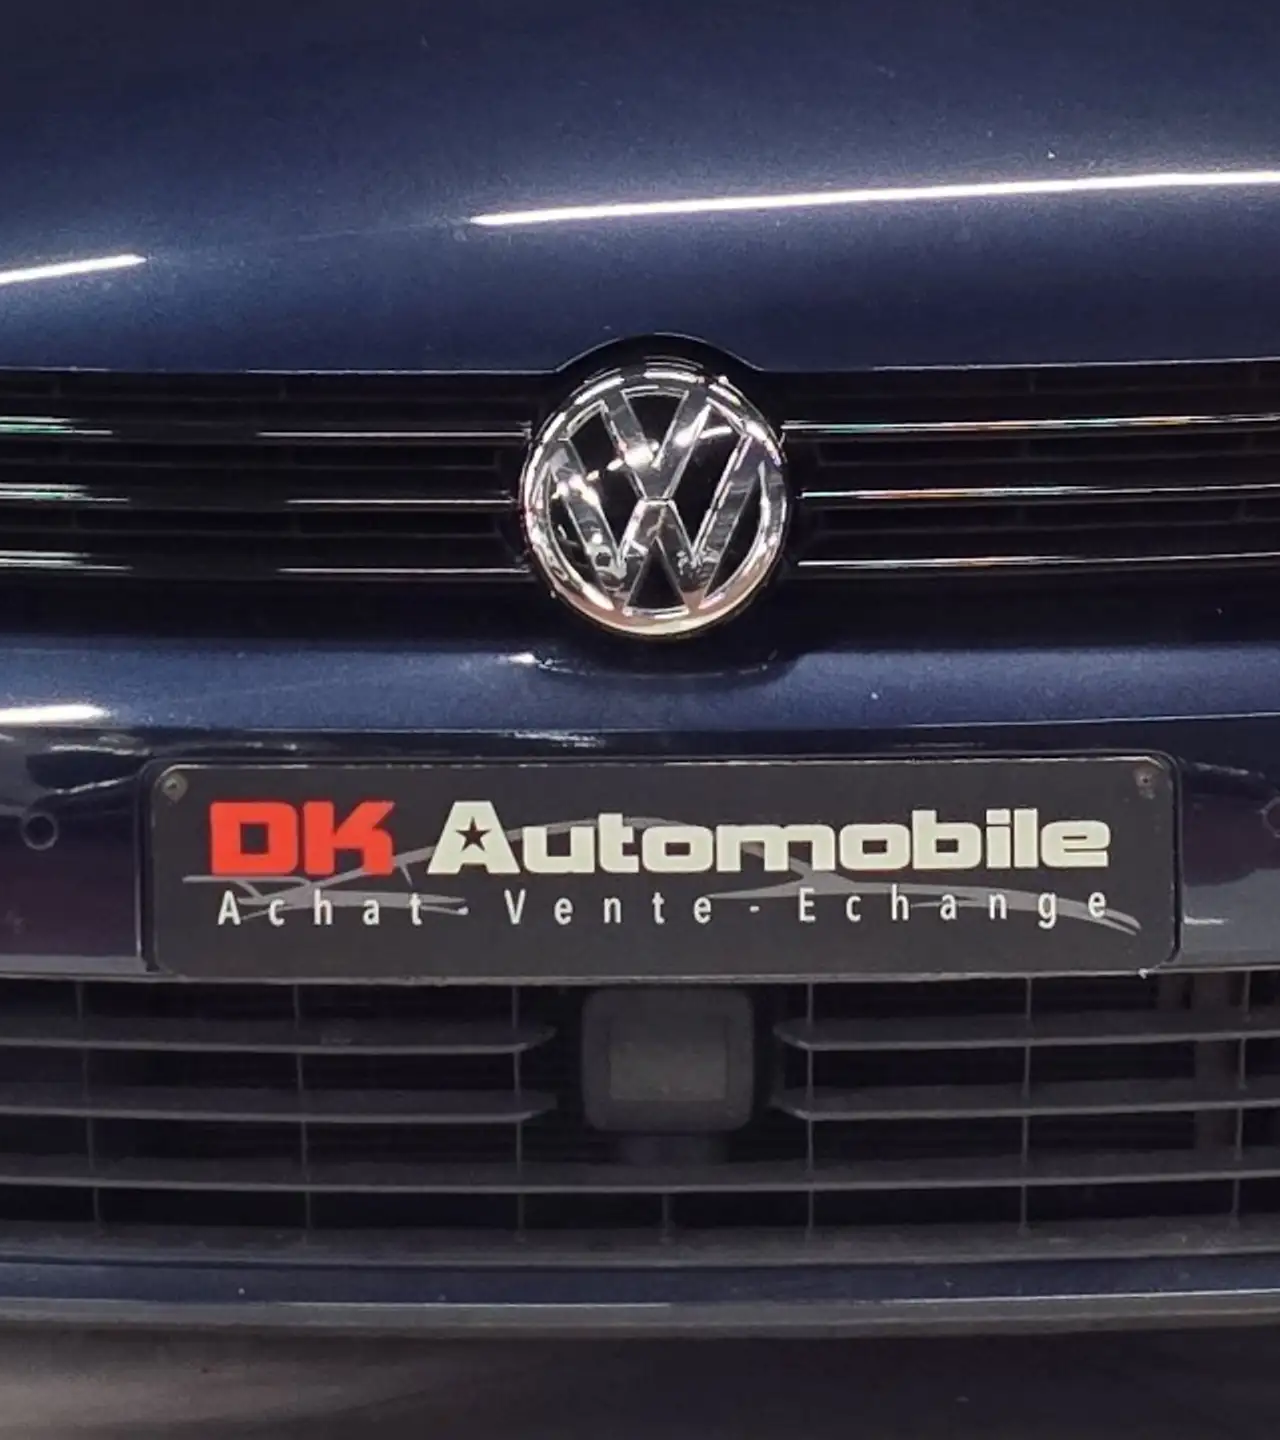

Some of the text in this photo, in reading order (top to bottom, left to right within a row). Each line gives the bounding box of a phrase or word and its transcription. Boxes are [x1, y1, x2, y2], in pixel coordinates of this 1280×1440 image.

[209, 800, 1111, 878] DK Automobile
[217, 889, 423, 927] Achat
[503, 888, 713, 926] Vente
[798, 883, 1107, 929] Echange
